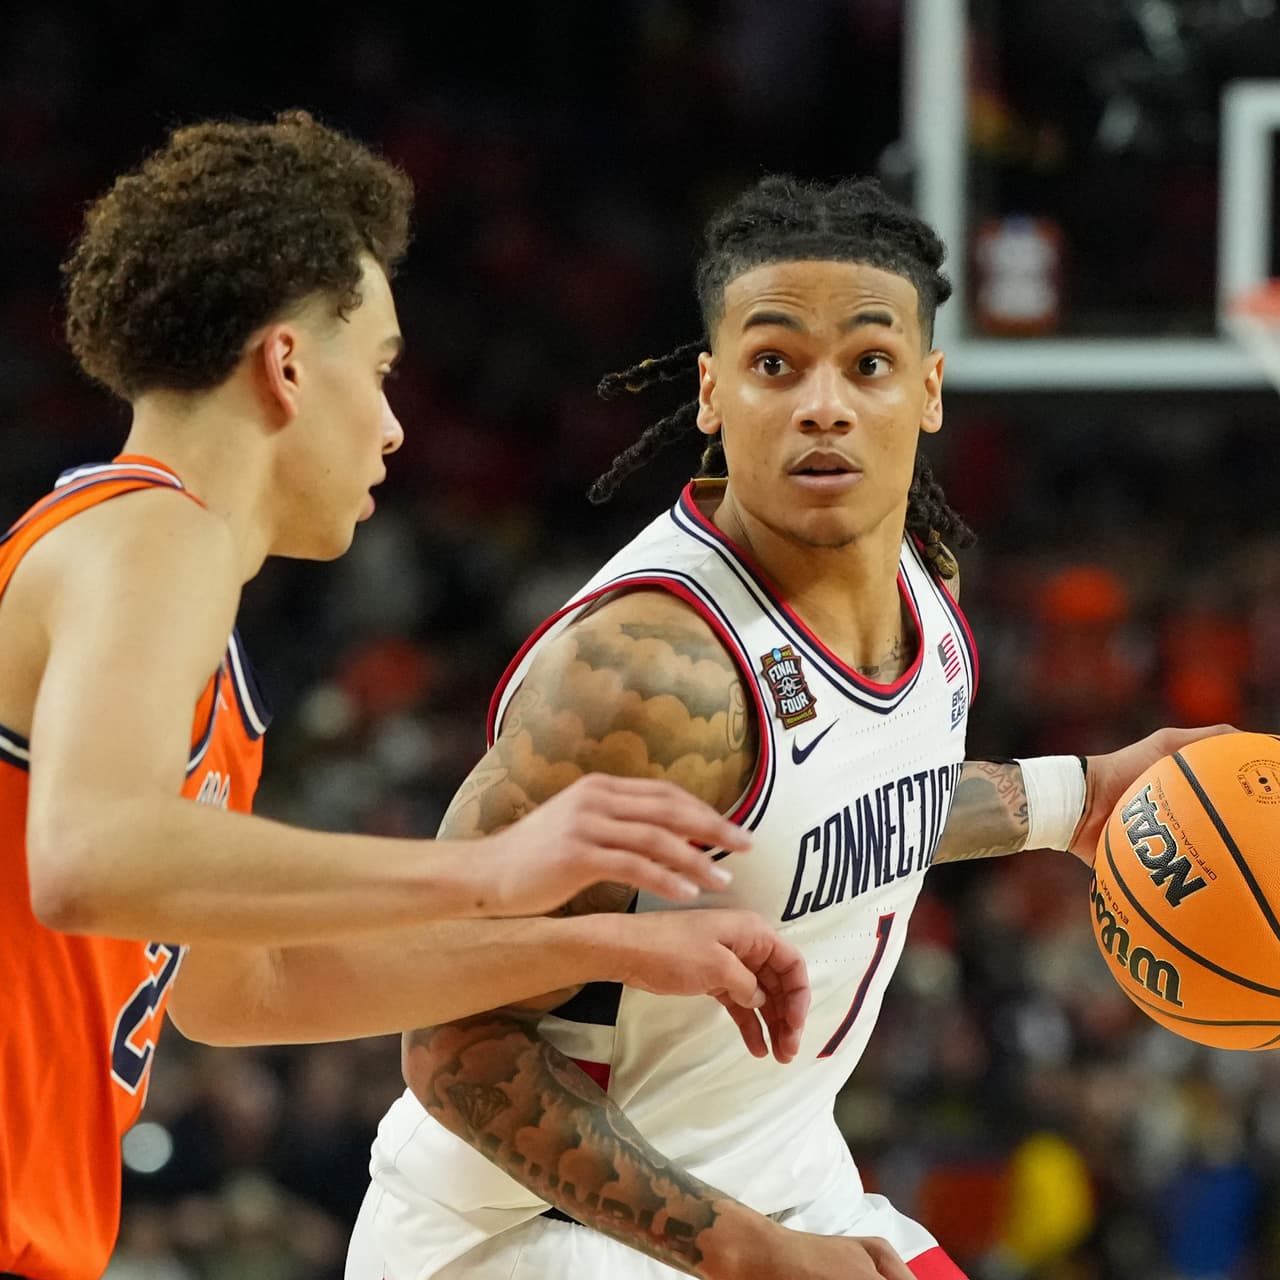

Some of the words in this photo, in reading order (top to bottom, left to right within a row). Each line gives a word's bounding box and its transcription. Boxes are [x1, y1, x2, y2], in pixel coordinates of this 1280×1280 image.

[768, 661, 799, 683] FINAL
[781, 692, 810, 714] FOUR
[781, 763, 962, 921] CONNECTIC
[1121, 782, 1208, 908] NCAA
[1178, 831, 1218, 881] OFFICIAL
[1111, 902, 1130, 925] EVO
[816, 912, 895, 1058] 1
